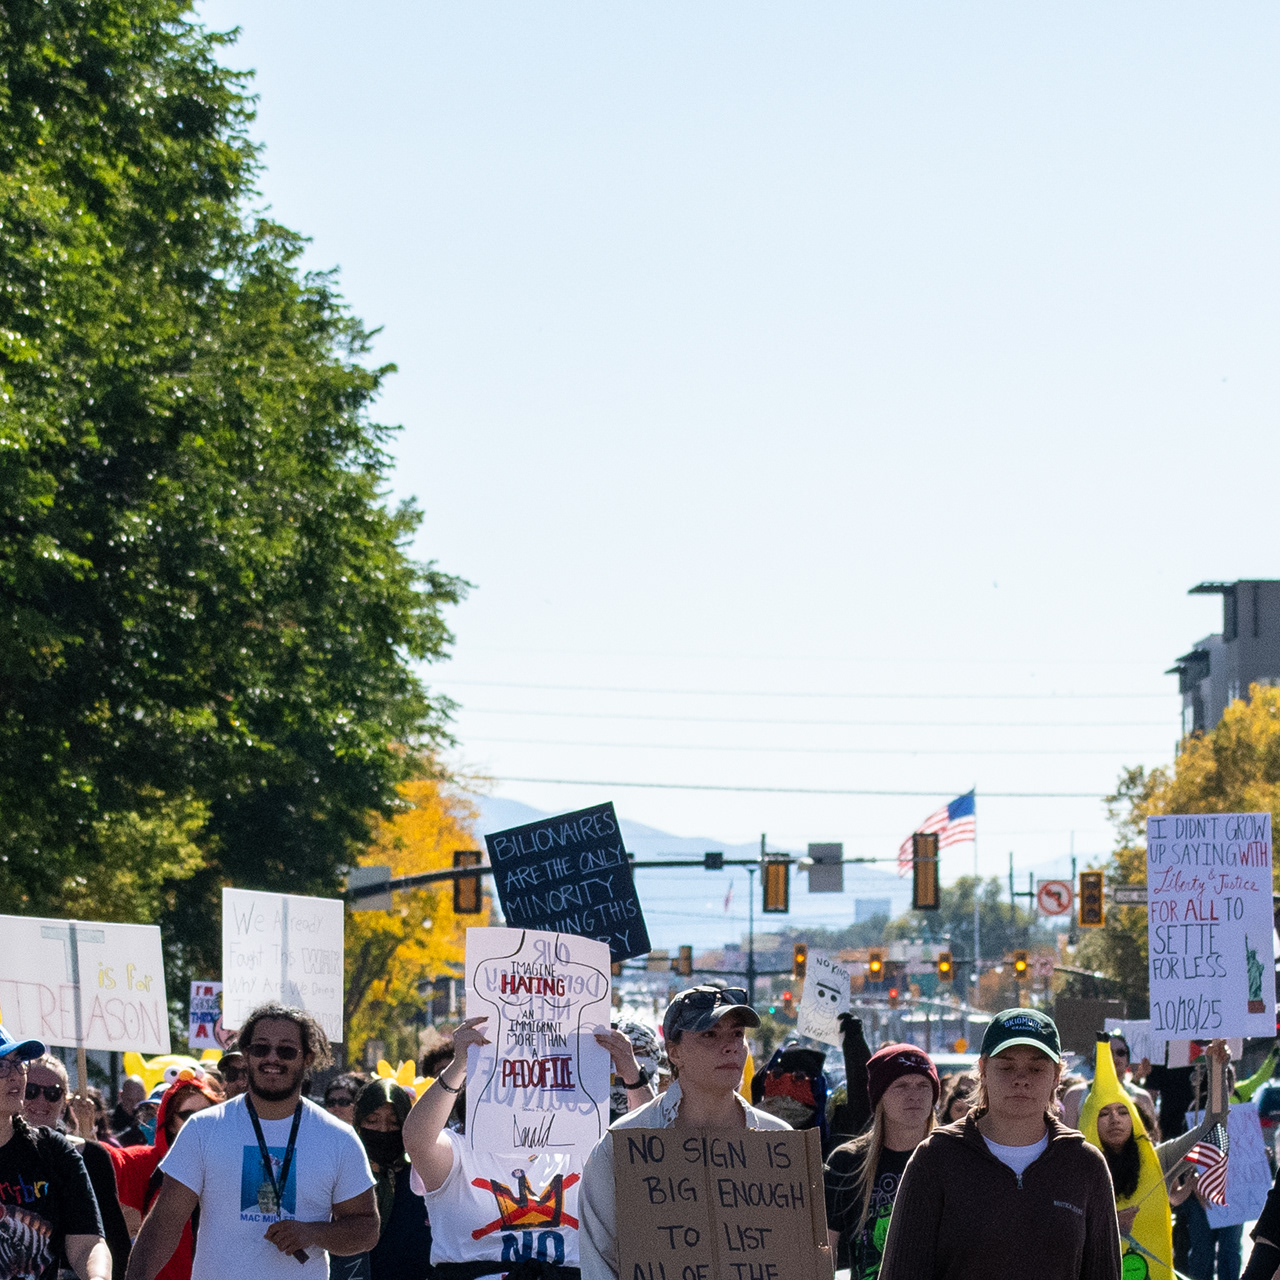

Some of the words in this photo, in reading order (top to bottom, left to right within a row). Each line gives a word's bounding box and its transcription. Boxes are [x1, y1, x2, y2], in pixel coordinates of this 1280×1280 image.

[1151, 819, 1167, 839] I
[1175, 818, 1219, 839] DIDN'T
[1225, 816, 1267, 840] GROW
[1150, 844, 1166, 865] UP
[1172, 843, 1237, 867] SAYING
[1239, 841, 1268, 867] WITH
[504, 865, 546, 893] ARE
[541, 857, 575, 881] THE
[580, 844, 623, 870] ONLY
[506, 875, 614, 922] MINORITY
[1151, 901, 1179, 923] FOR
[1184, 899, 1219, 921] ALL
[1224, 897, 1244, 921] TO
[594, 899, 637, 926] THIS
[511, 961, 556, 978] IMAGINE
[817, 957, 830, 968] NO
[1153, 957, 1179, 980] FOR
[1184, 955, 1228, 980] LESS
[501, 974, 565, 996] HATING
[508, 1019, 563, 1033] IMMIGRANT
[522, 1009, 534, 1020] AN
[1153, 994, 1222, 1034] 10/18/25
[195, 1024, 208, 1038] A
[507, 1034, 536, 1047] MORE
[543, 1034, 567, 1048] THAN
[532, 1048, 538, 1059] A
[627, 1134, 665, 1164] NO
[682, 1137, 747, 1169] SIGN
[766, 1141, 791, 1169] IS
[642, 1176, 698, 1205] BIG
[717, 1178, 805, 1210] ENOUGH
[240, 1214, 260, 1222] MAC
[501, 1231, 565, 1265] NO
[657, 1225, 700, 1250] TO
[723, 1222, 772, 1252] LIST
